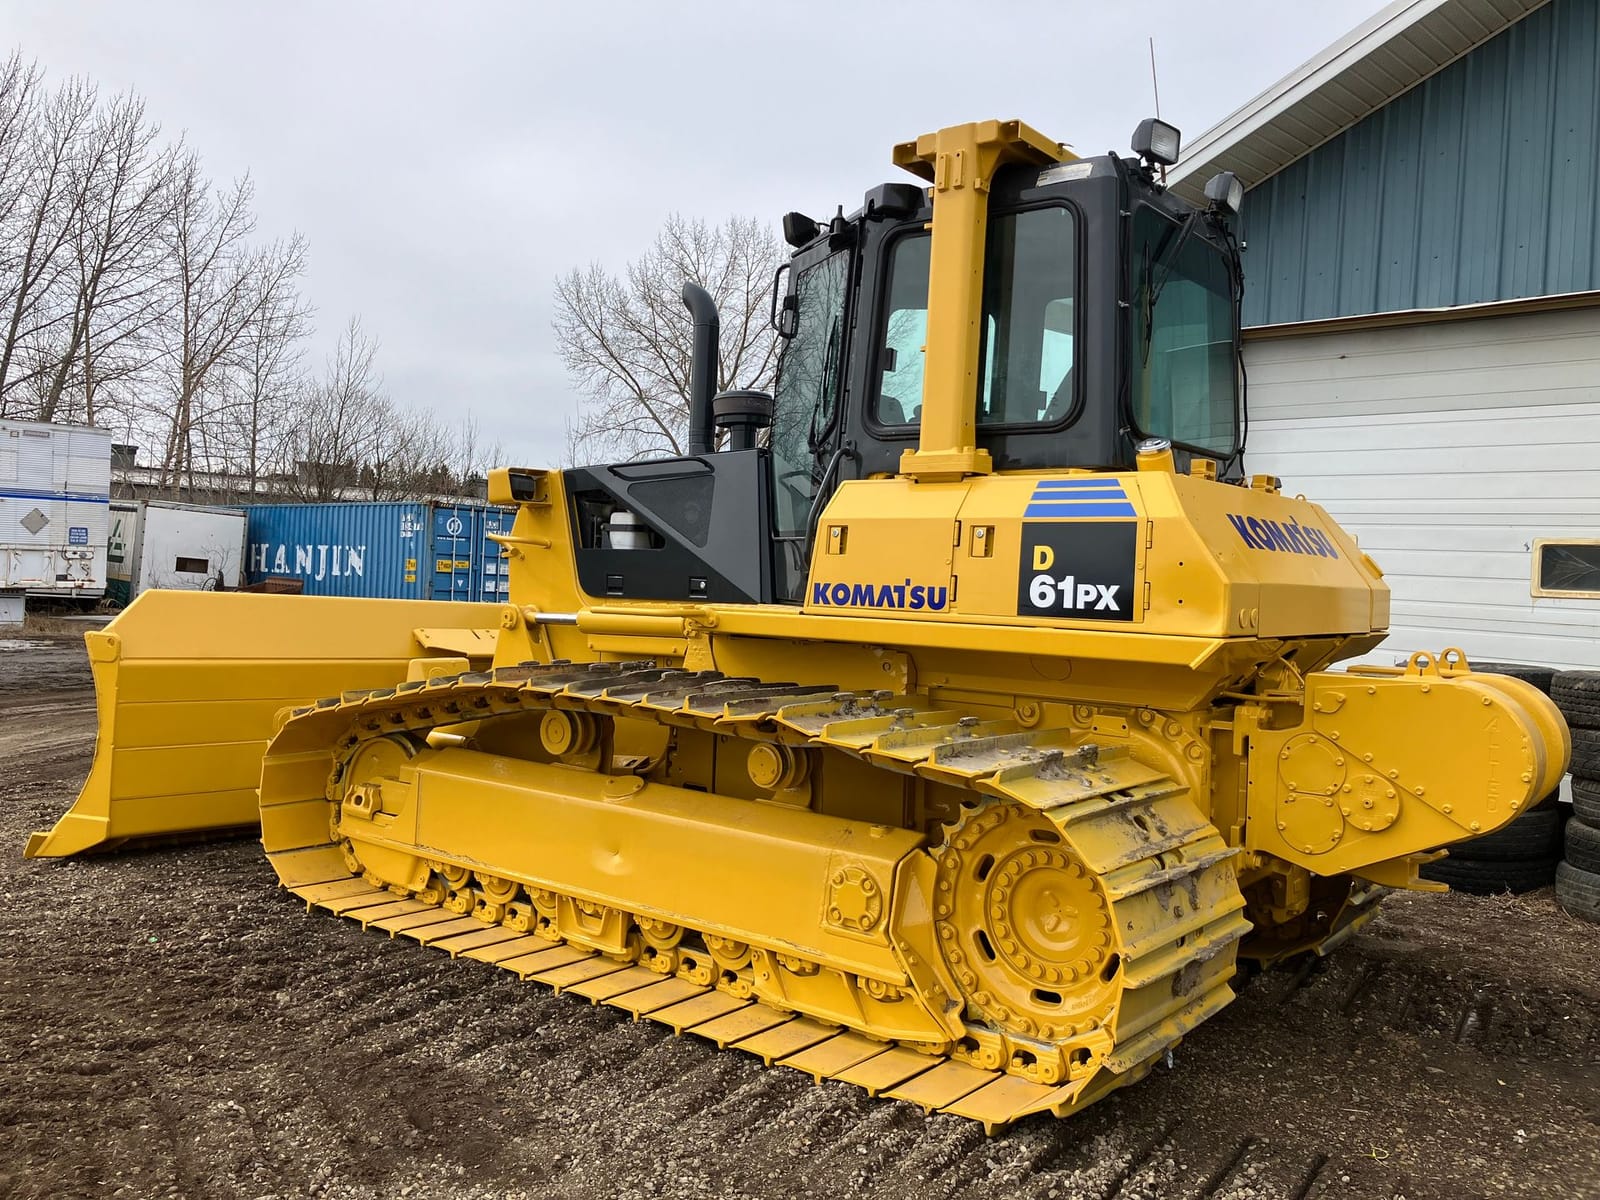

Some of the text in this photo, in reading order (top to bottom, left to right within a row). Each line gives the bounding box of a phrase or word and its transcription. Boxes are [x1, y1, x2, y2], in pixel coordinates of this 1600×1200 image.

[1226, 512, 1339, 560] KOMATSU
[250, 543, 366, 582] HANJIN
[1032, 545, 1055, 571] D
[813, 578, 947, 610] KOMATSU
[1029, 574, 1120, 611] 61PX
